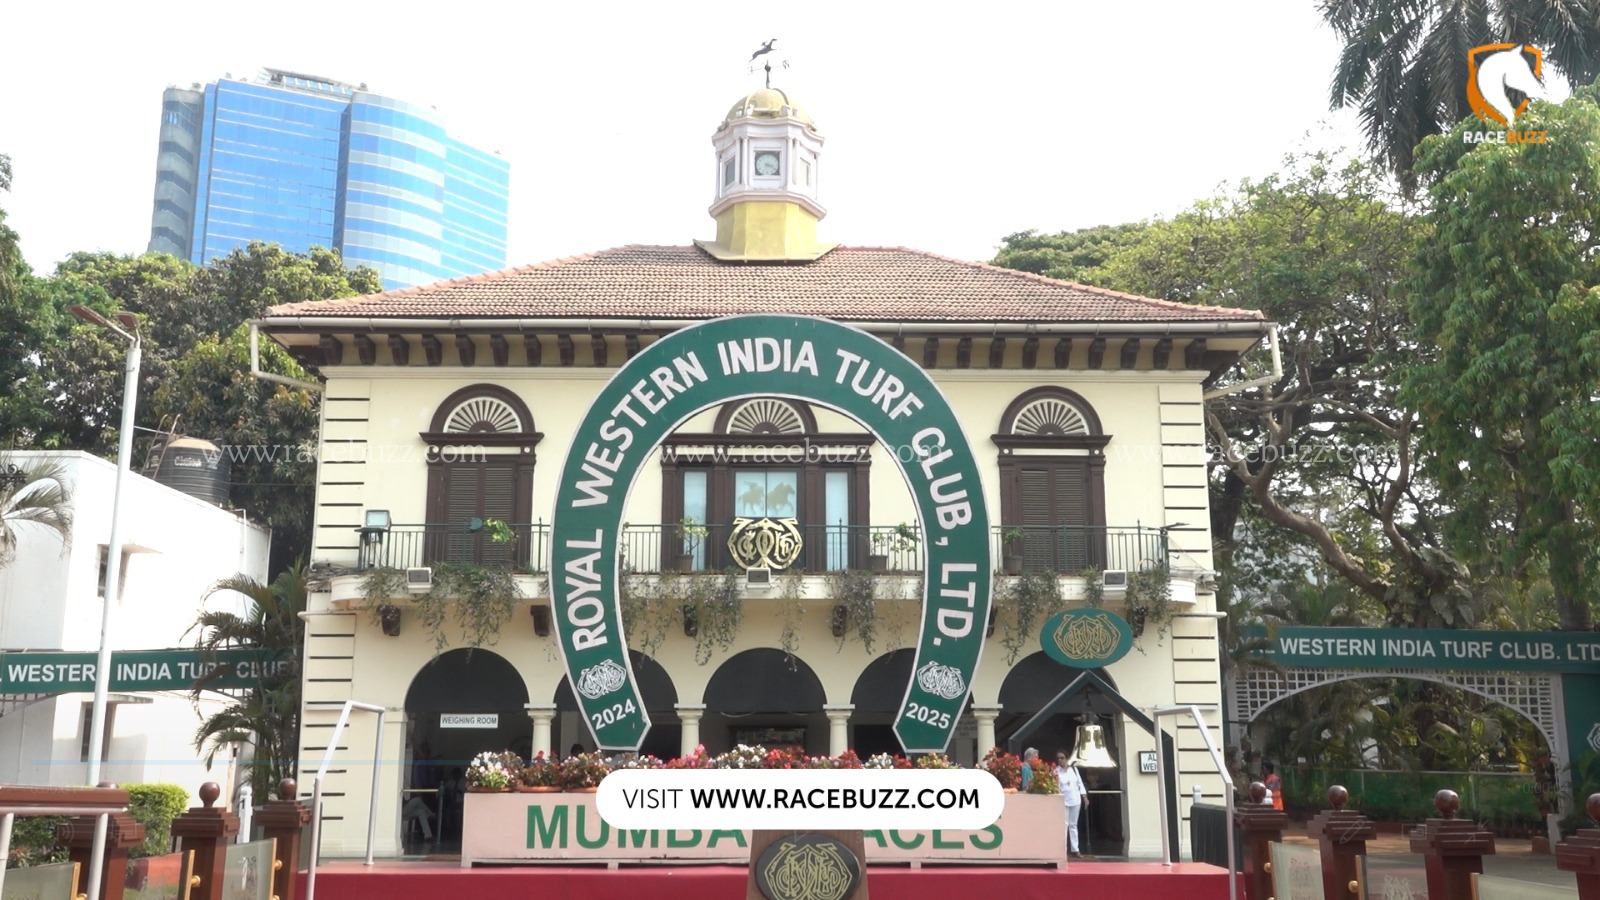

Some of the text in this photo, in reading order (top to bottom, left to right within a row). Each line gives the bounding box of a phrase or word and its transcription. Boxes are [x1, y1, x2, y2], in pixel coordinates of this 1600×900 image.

[717, 337, 819, 376] INDIA
[835, 348, 925, 420] TURF
[572, 351, 708, 508] WESTERN
[911, 427, 973, 546] CLUB,
[565, 529, 608, 651] ROYAL
[933, 563, 977, 647] LTD.
[1280, 637, 1376, 656] WESTERN
[1382, 638, 1436, 657] INDIA
[1441, 641, 1493, 659] TURF
[8, 664, 98, 682] WESTER
[117, 663, 172, 681] INDIA
[177, 662, 230, 680] TUR
[441, 716, 497, 725] WEIGHING ROOM
[591, 699, 636, 731] 2024
[905, 702, 951, 729] 2025
